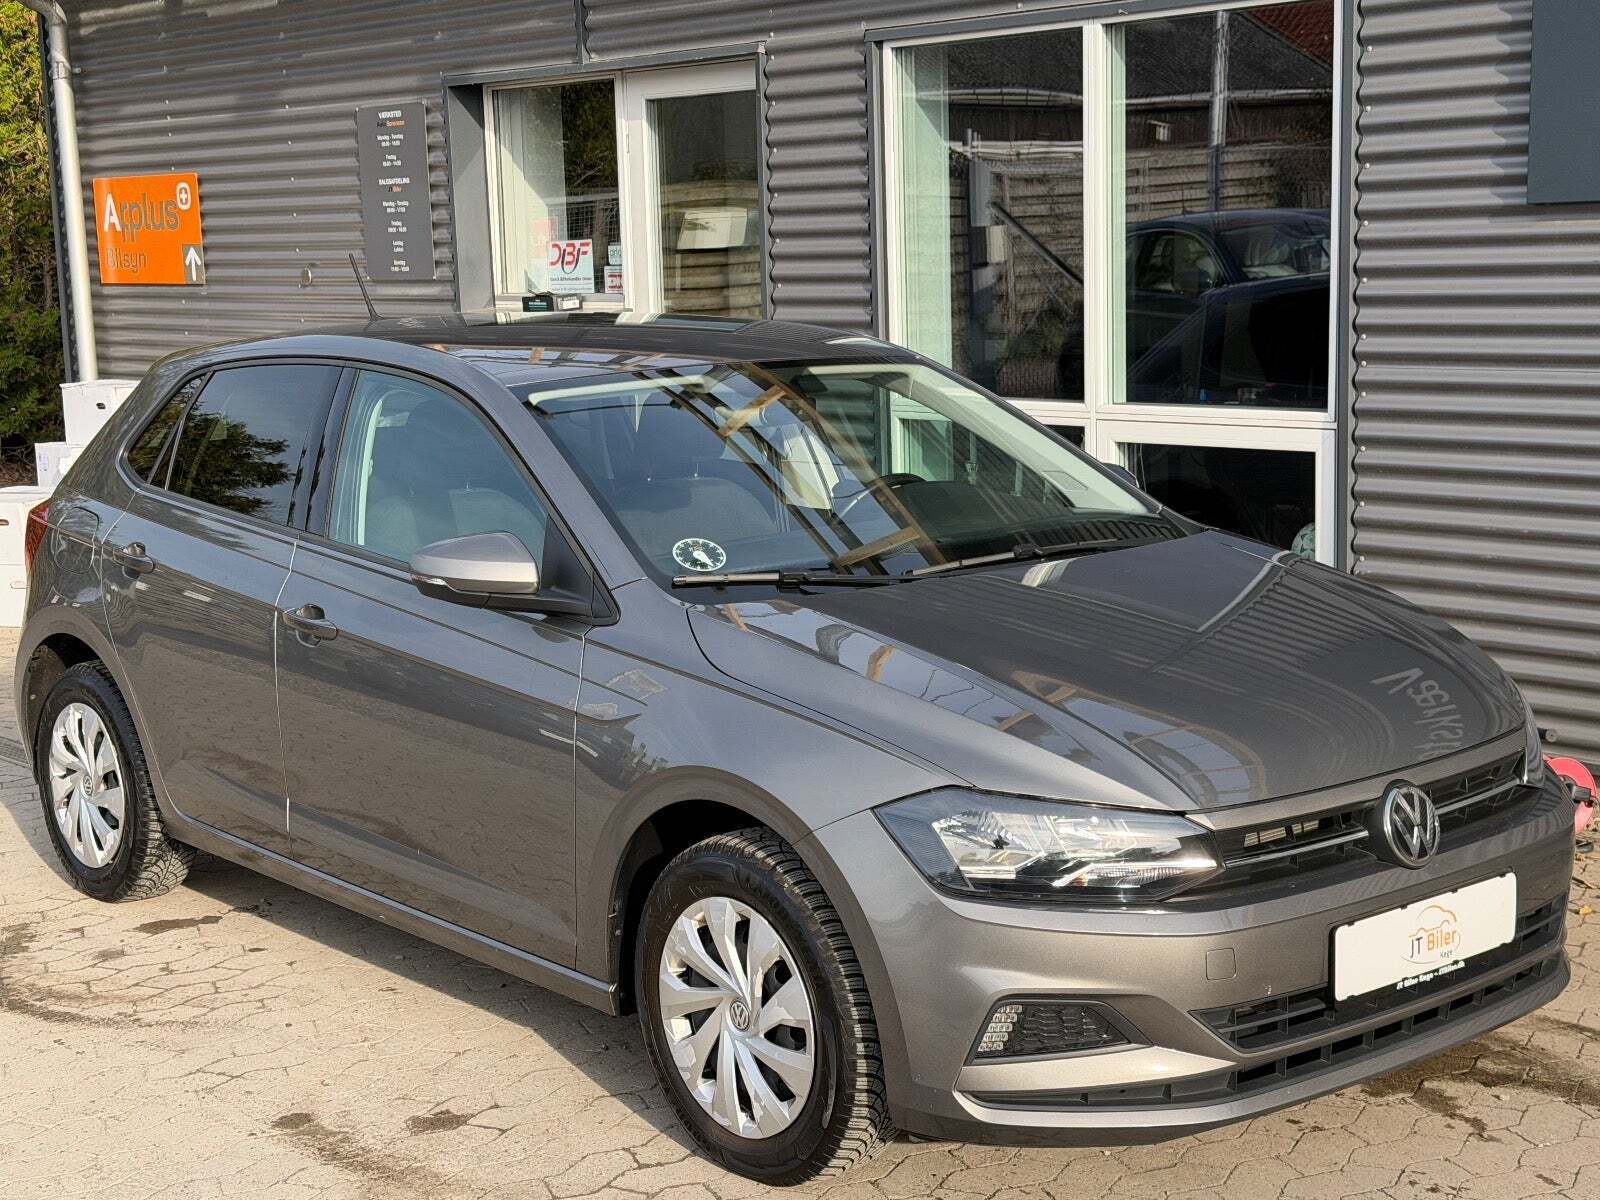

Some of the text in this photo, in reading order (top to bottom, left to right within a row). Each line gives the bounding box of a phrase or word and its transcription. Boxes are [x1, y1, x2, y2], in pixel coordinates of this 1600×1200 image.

[106, 247, 147, 273] Bilsyn
[1409, 929, 1457, 959] JT Biler
